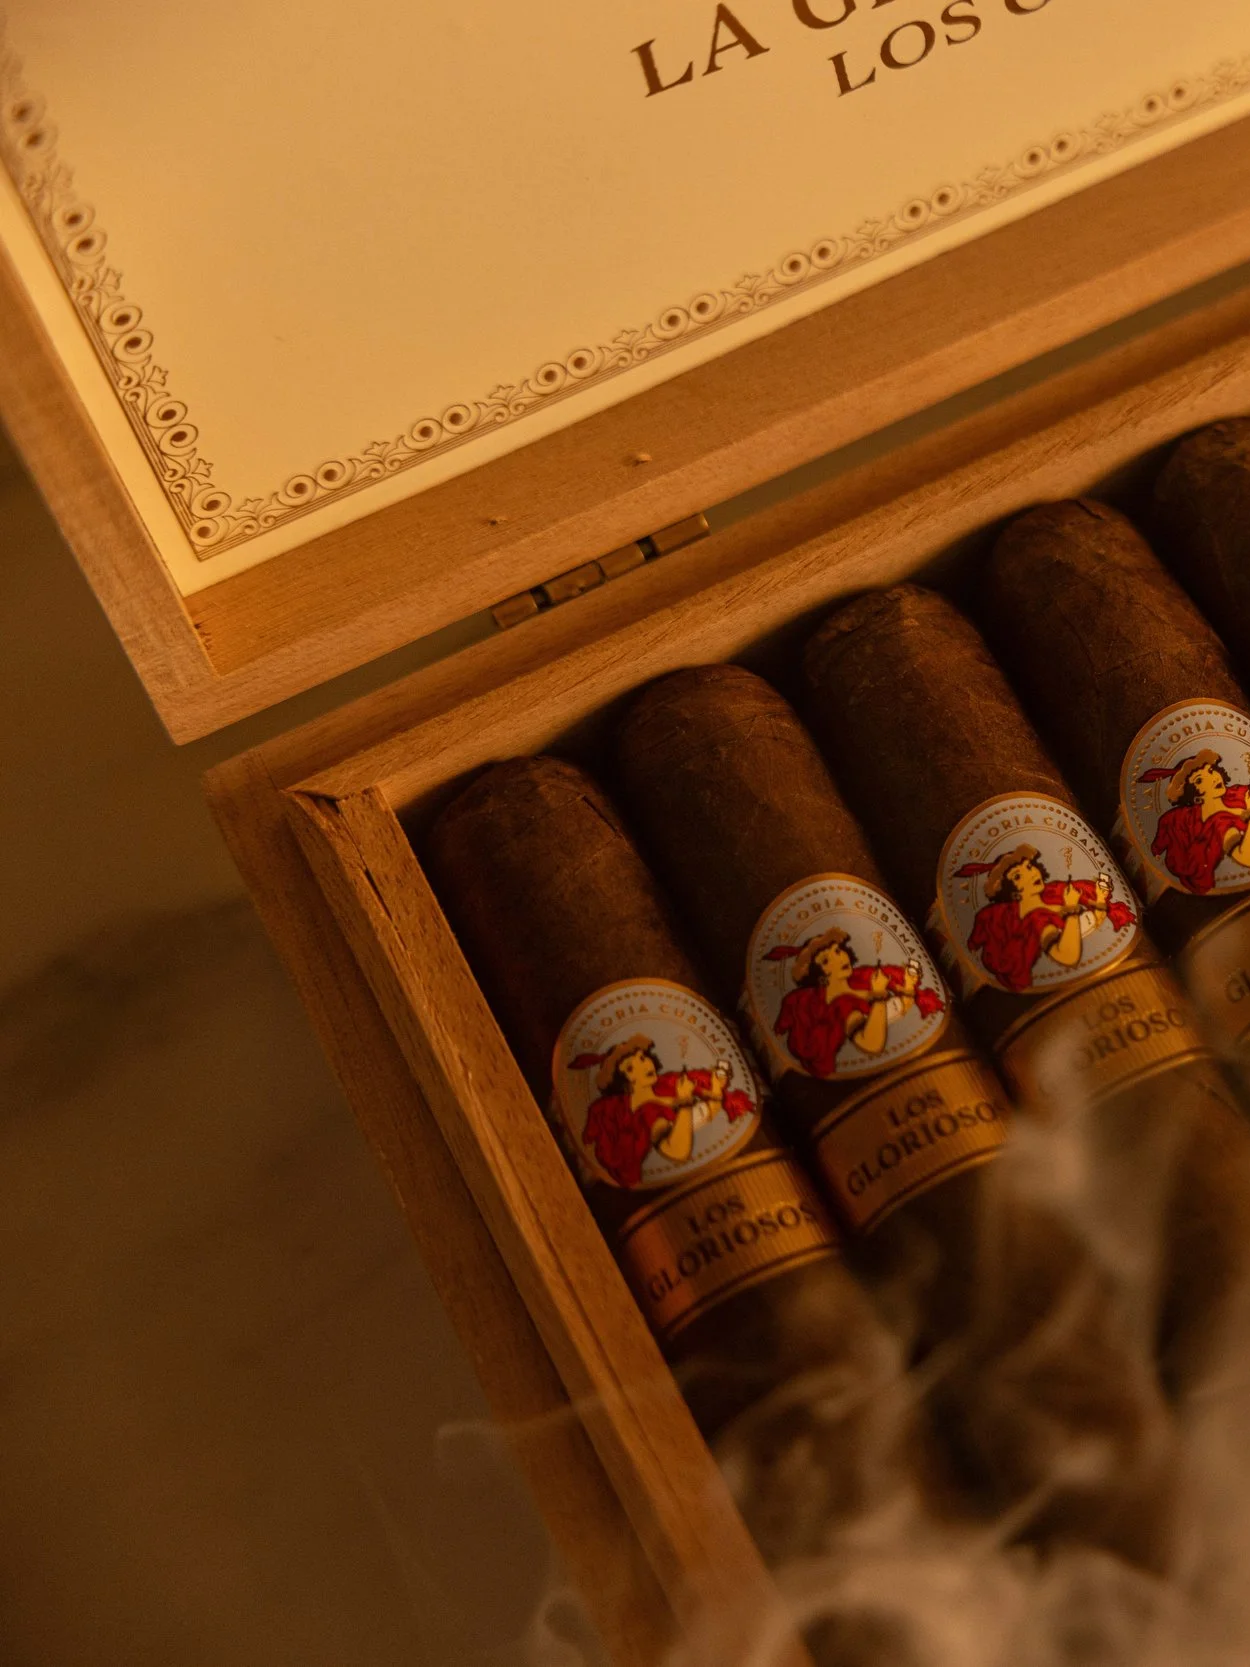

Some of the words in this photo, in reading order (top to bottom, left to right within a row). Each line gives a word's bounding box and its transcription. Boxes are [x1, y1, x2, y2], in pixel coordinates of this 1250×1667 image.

[631, 2, 770, 98] LA
[827, 0, 982, 97] LOS
[1151, 720, 1216, 765] GLORIA
[968, 814, 1035, 860] GLORIA
[1043, 815, 1107, 869] CUBANA
[777, 897, 845, 942] GLORIA
[854, 897, 917, 956] CUBANA
[658, 1003, 727, 1056] CUBANA
[1081, 994, 1137, 1031] LOS
[885, 1088, 944, 1128] LOS
[685, 1195, 745, 1235] LOS
